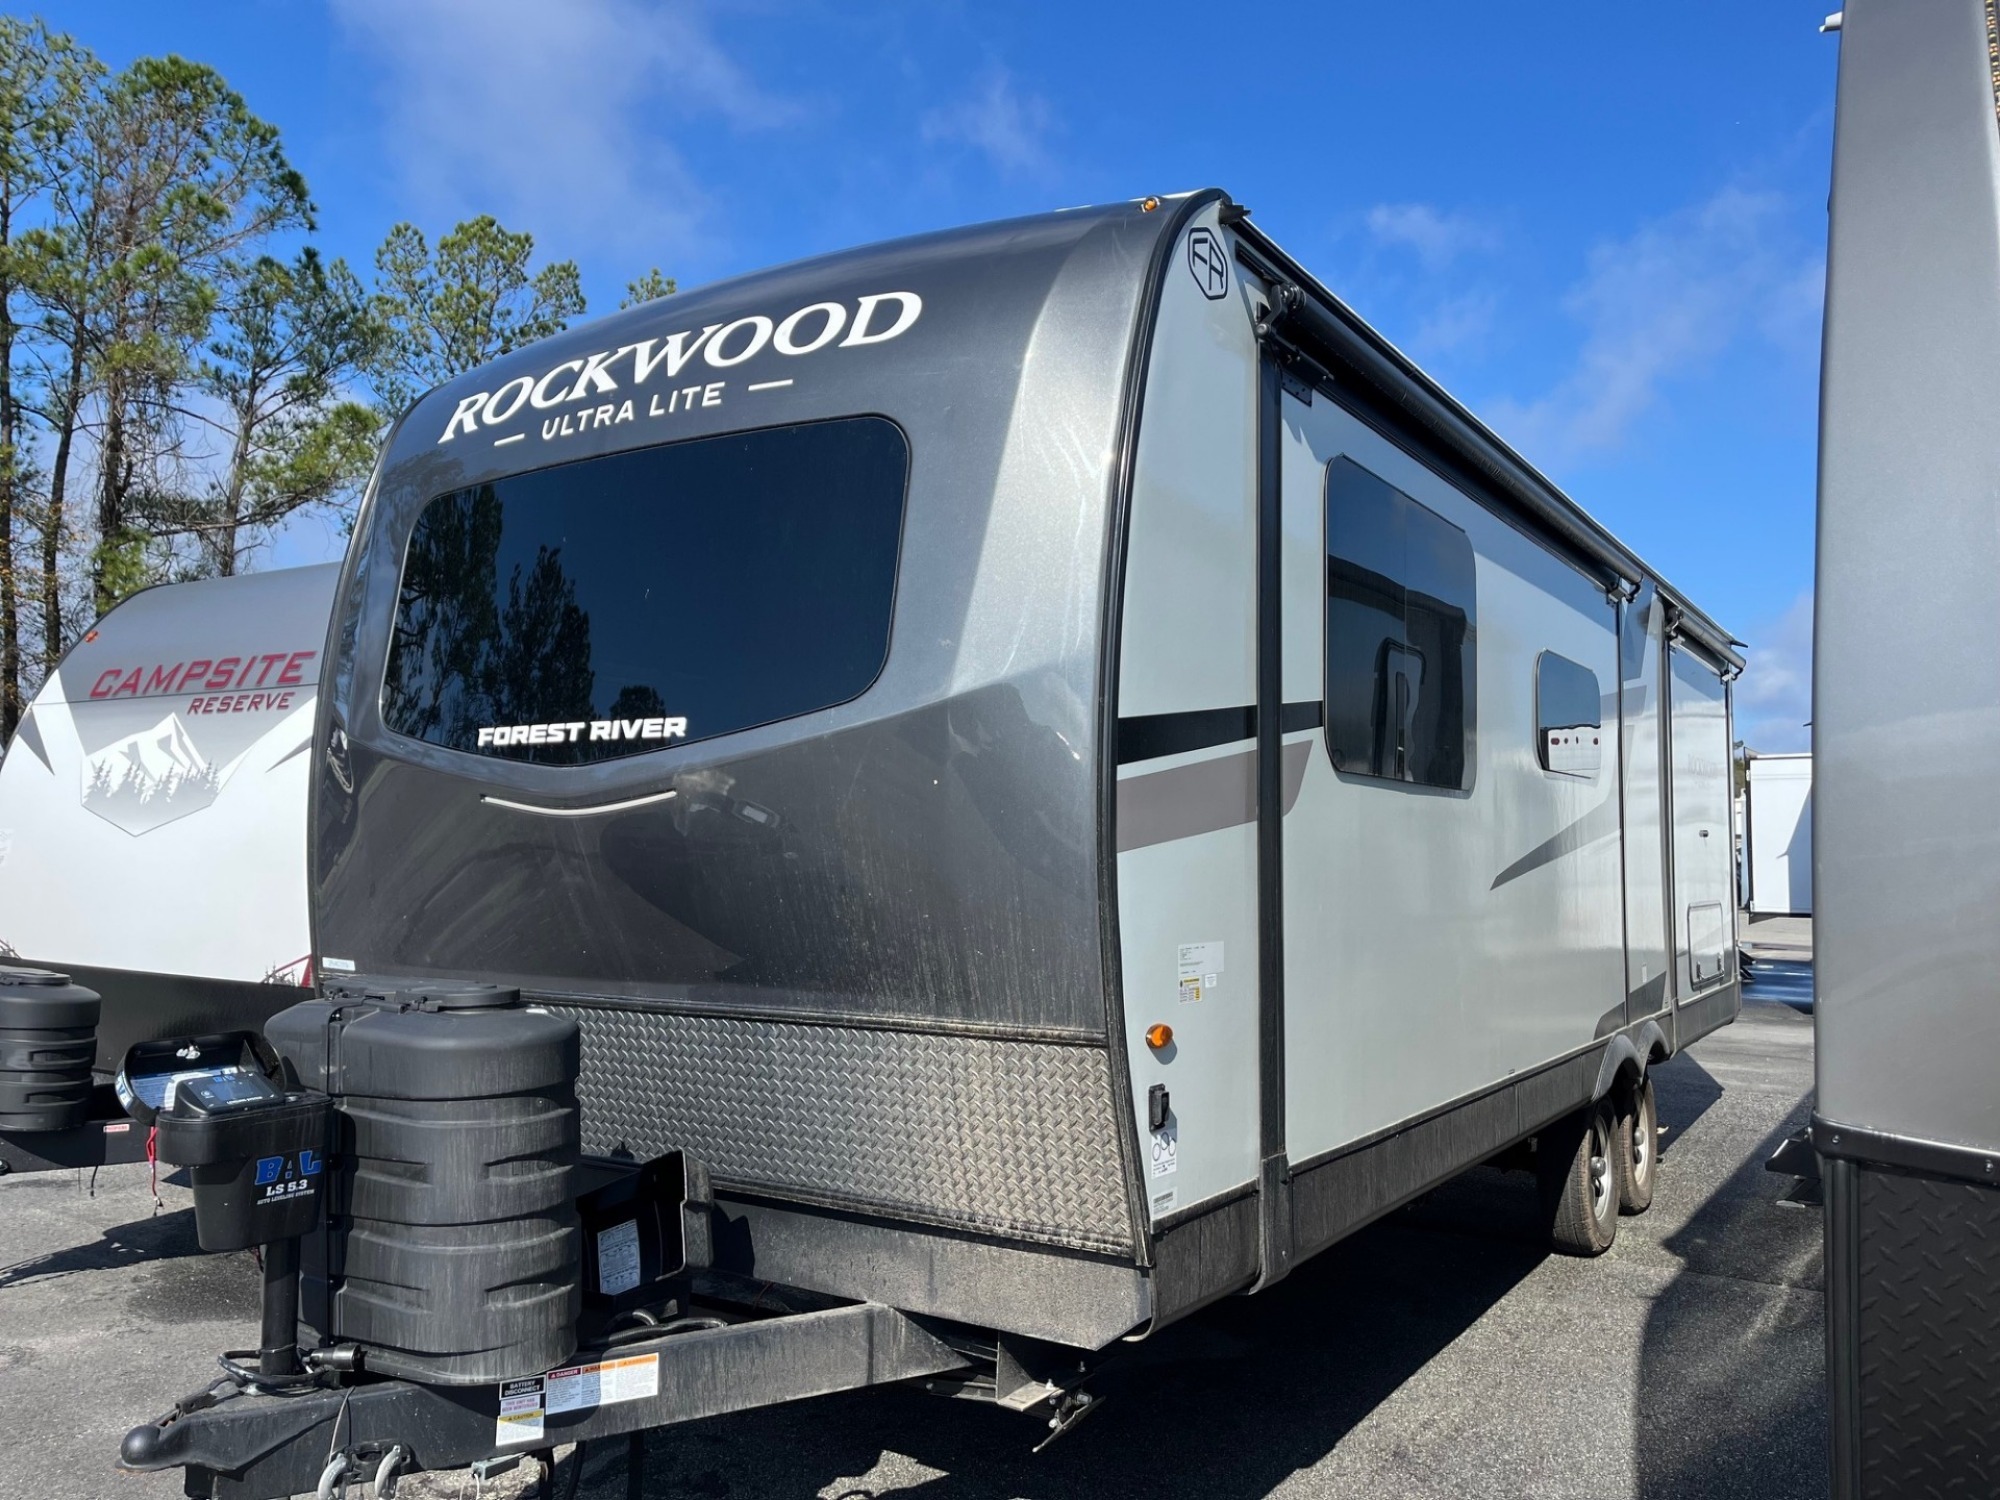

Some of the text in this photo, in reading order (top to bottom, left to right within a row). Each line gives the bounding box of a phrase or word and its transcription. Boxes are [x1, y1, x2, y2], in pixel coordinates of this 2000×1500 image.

[437, 290, 923, 444] ROCKWOOD
[541, 381, 726, 441] ULTRA LITE
[89, 650, 317, 699] CAMPSITE
[187, 691, 296, 715] RESERVE
[477, 716, 688, 747] FOREST RIVER
[266, 1179, 308, 1197] LS 5.3
[510, 1380, 536, 1389] BATTERY
[556, 1369, 578, 1378] DANGER
[504, 1384, 541, 1396] DISCONNECT
